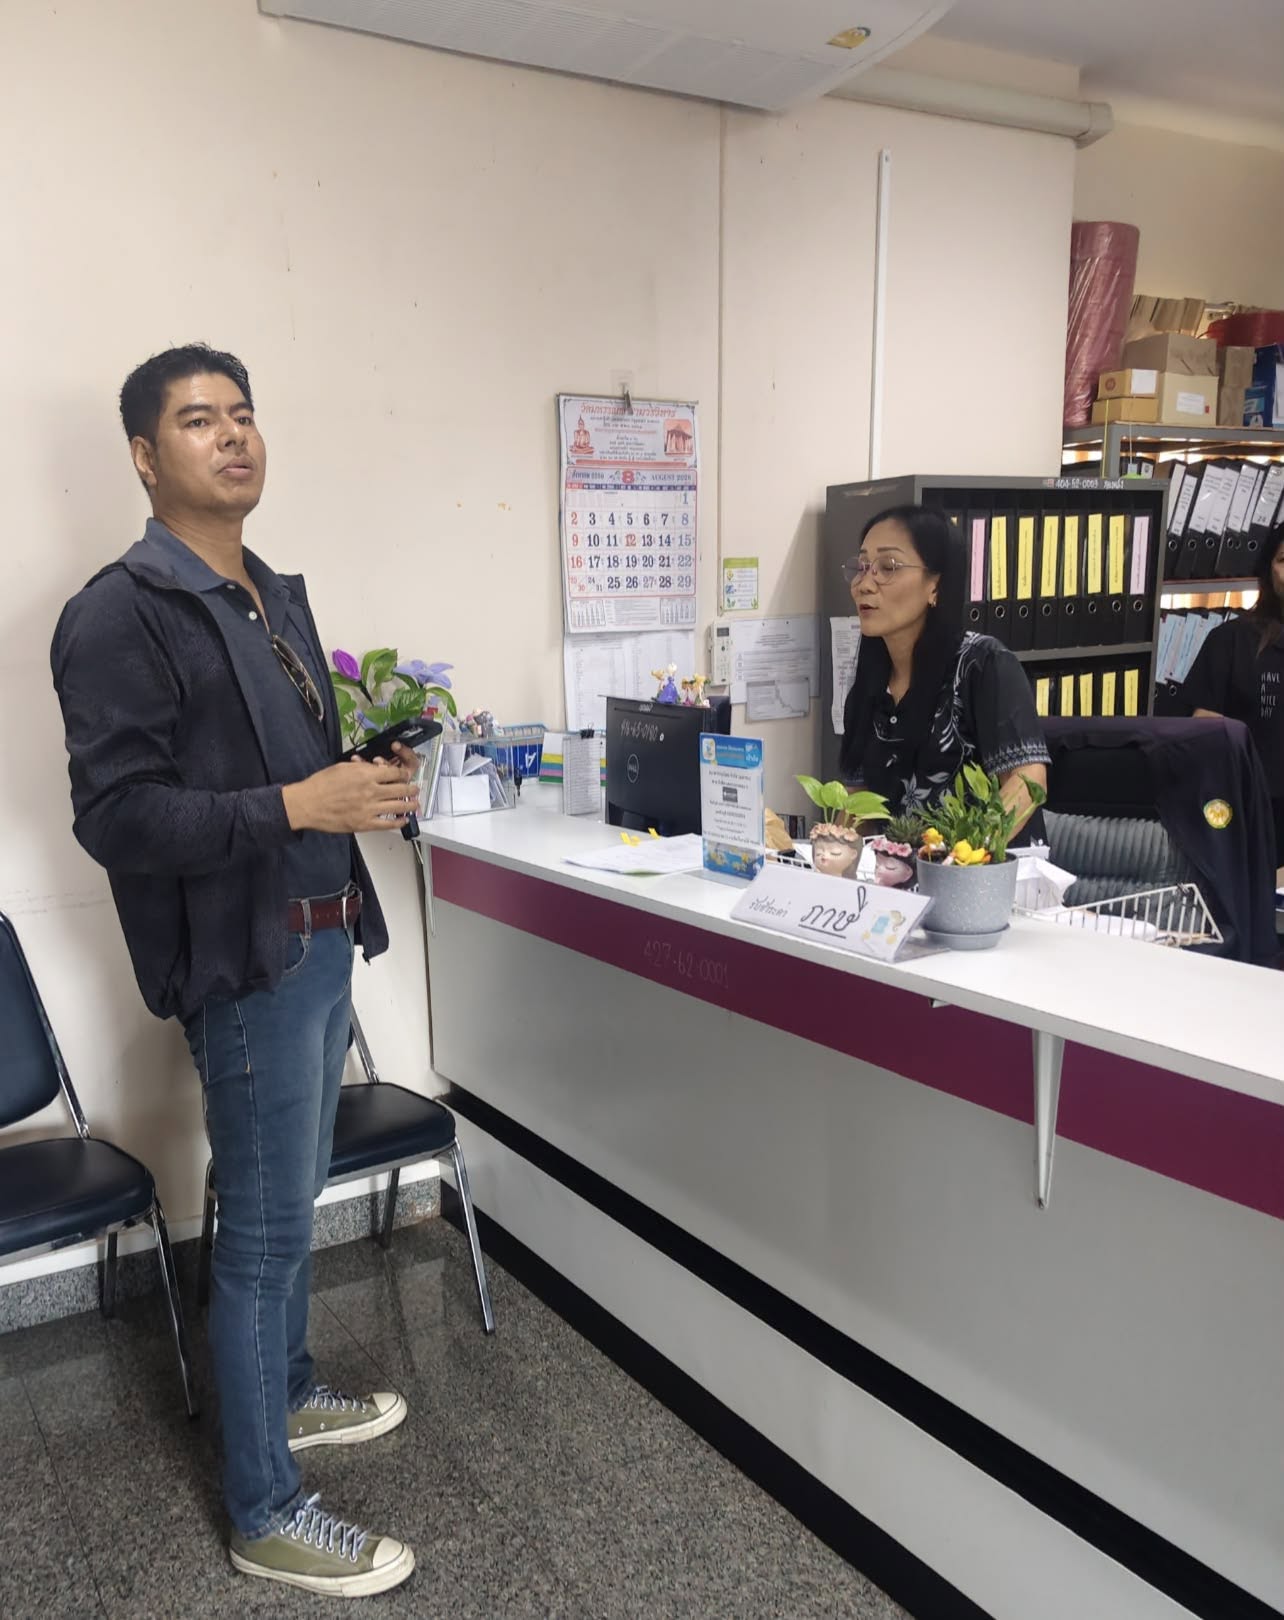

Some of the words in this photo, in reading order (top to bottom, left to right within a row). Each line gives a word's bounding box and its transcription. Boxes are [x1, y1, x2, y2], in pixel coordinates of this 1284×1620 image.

[621, 470, 635, 484] 8
[682, 493, 688, 505] 1
[571, 512, 578, 525] 2
[589, 512, 596, 526] 3
[608, 514, 615, 525] 4
[626, 513, 633, 525] 5
[643, 513, 650, 526] 6
[661, 513, 668, 525] 7
[681, 514, 689, 525] 8
[571, 534, 578, 547] 9
[587, 534, 600, 547] 10
[606, 535, 618, 547] 11
[625, 534, 637, 547] 12
[641, 534, 653, 547] 13
[658, 534, 671, 547] 14
[677, 534, 691, 547] 15
[570, 556, 582, 568] 16
[588, 556, 601, 568] 17
[607, 555, 620, 568] 18
[625, 555, 637, 568] 19
[642, 555, 654, 568] 20
[658, 555, 671, 568] 21
[677, 555, 692, 568] 22
[587, 576, 596, 584] 24
[607, 576, 621, 589] 25
[625, 576, 638, 589] 26
[642, 576, 654, 589] 27
[658, 576, 672, 589] 28
[677, 576, 691, 588] 29
[799, 884, 869, 932] ภาษี
